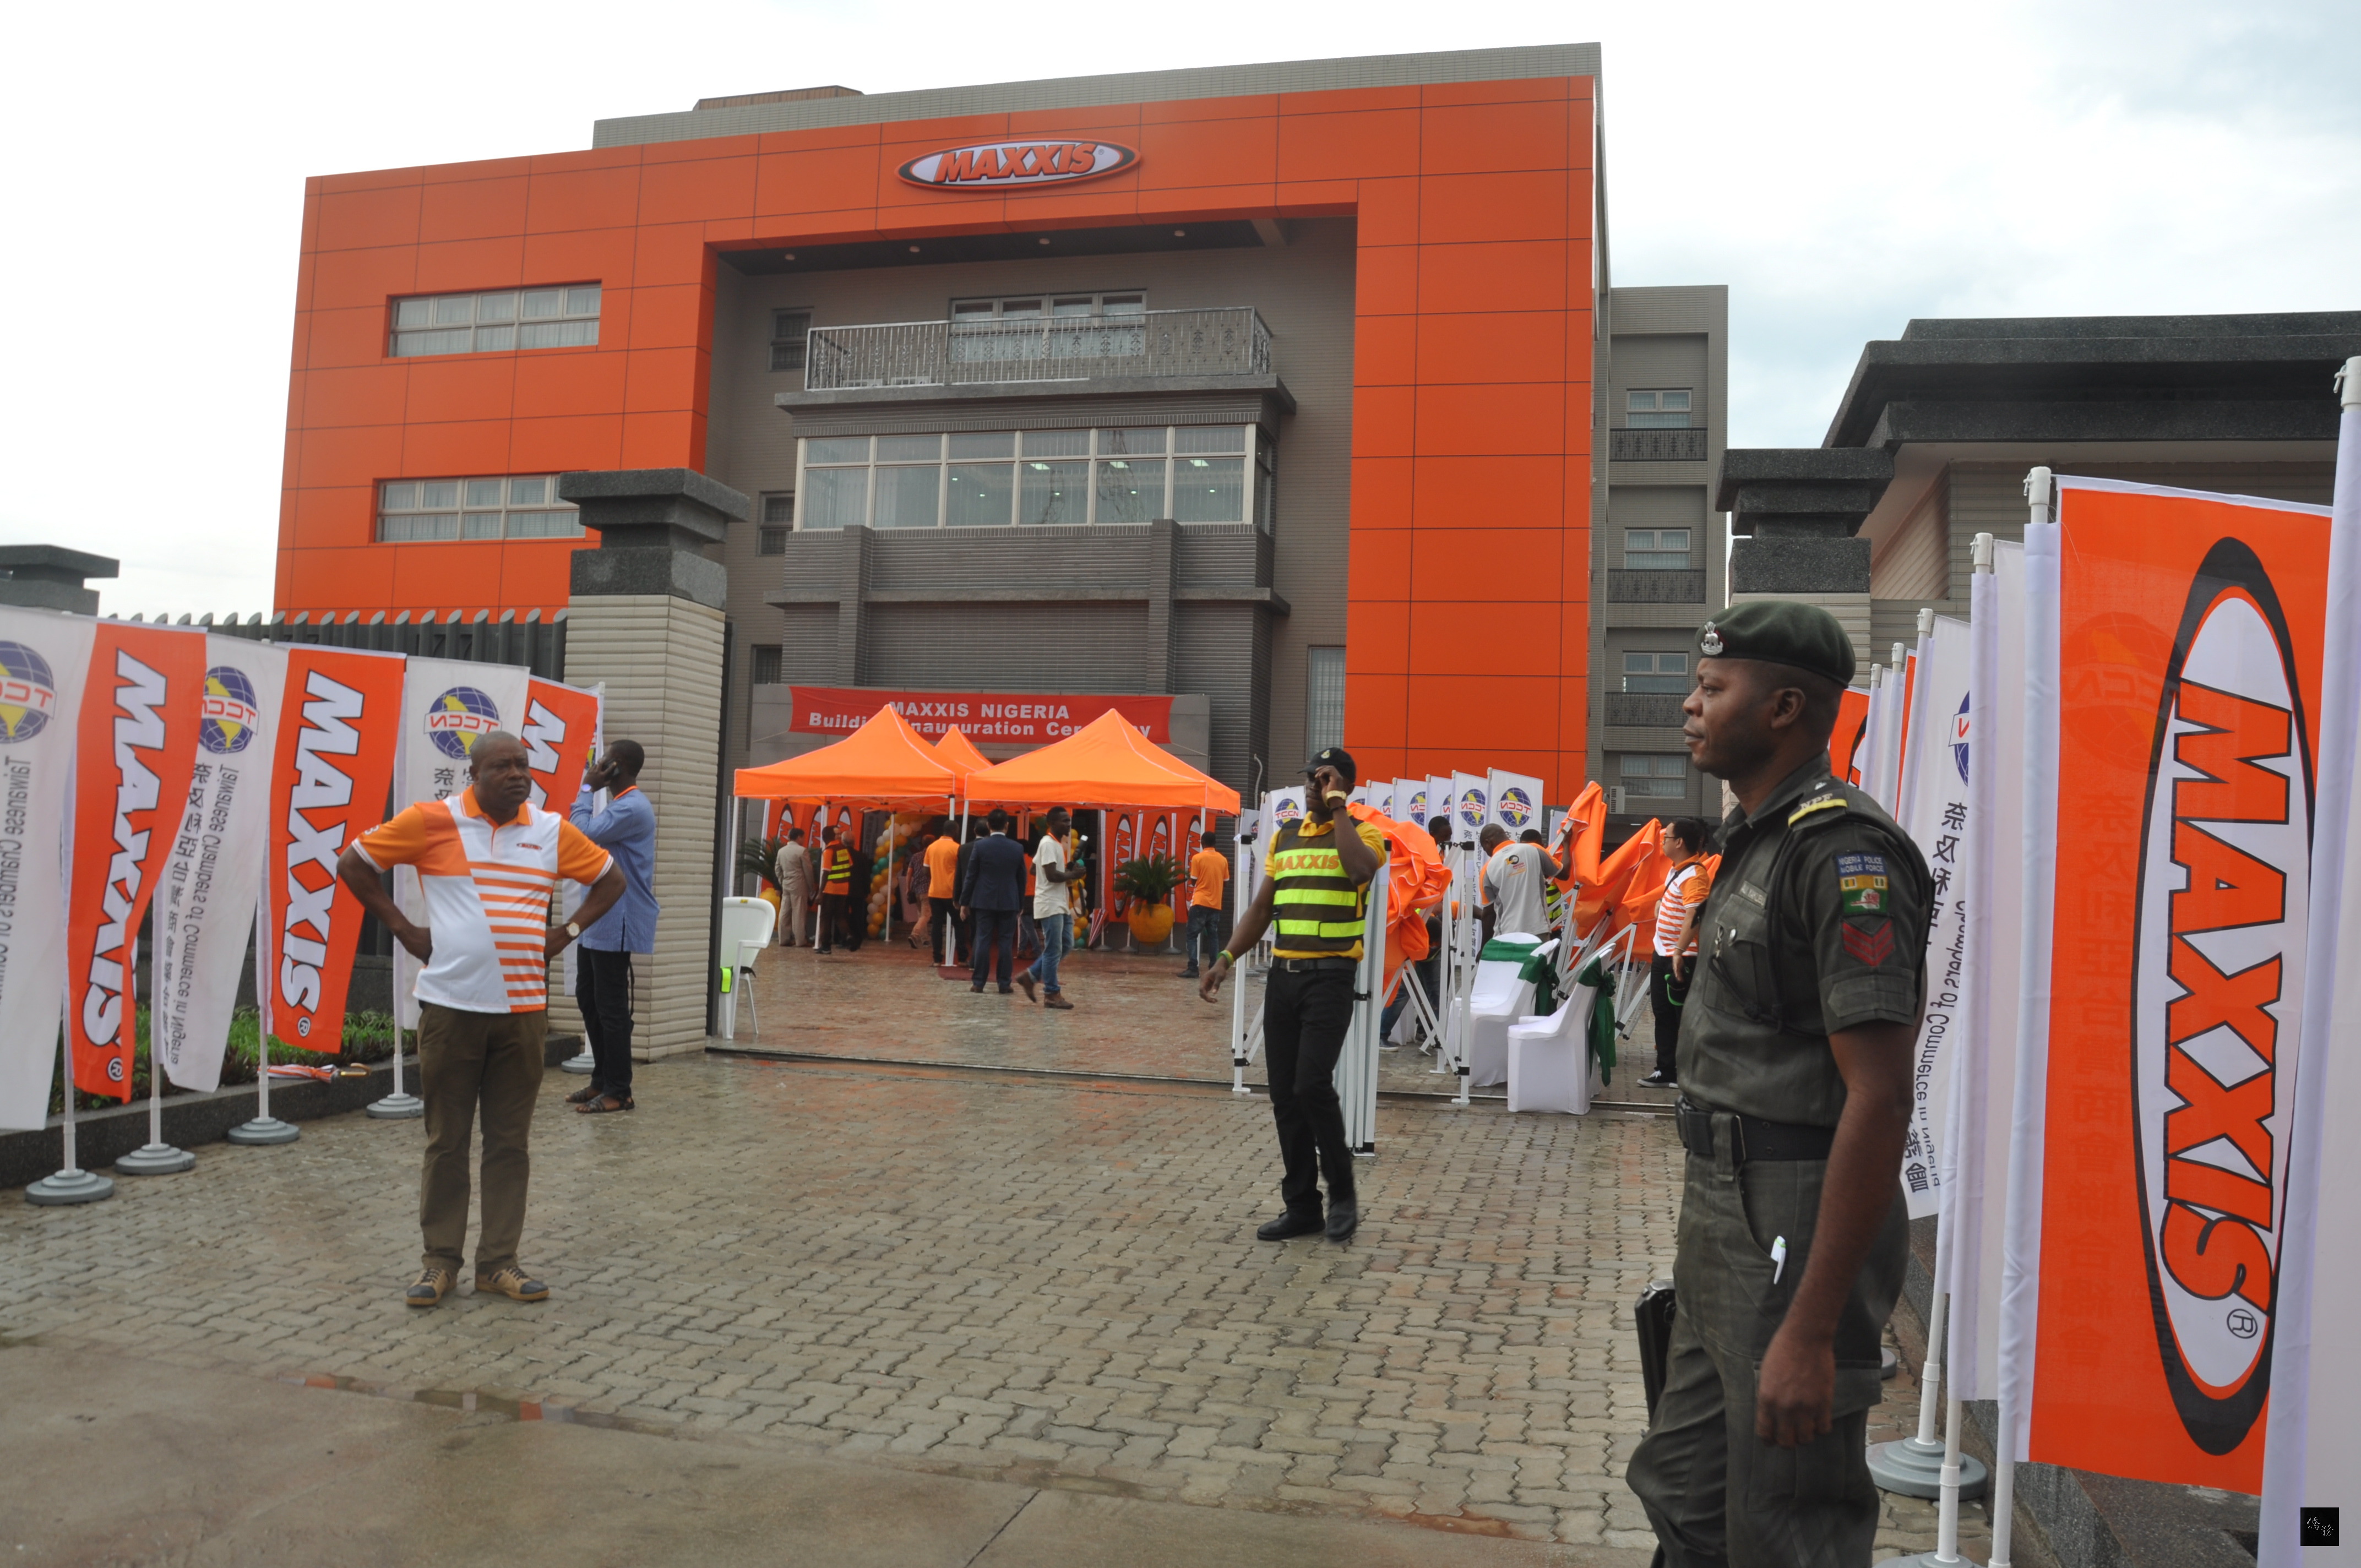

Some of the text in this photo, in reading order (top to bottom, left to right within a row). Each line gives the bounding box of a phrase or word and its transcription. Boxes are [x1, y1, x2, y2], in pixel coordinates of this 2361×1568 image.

[934, 143, 1097, 183] MAXXIS
[889, 701, 1069, 719] MAXXIS NIGERIA
[1275, 810, 1299, 819] TCCN
[280, 668, 365, 1014] MAXXIS
[1275, 854, 1340, 873] MAXXIS
[1863, 856, 1883, 865] POLICE
[1865, 864, 1885, 872] FORCE
[2159, 676, 2293, 1317] MAXXIS
